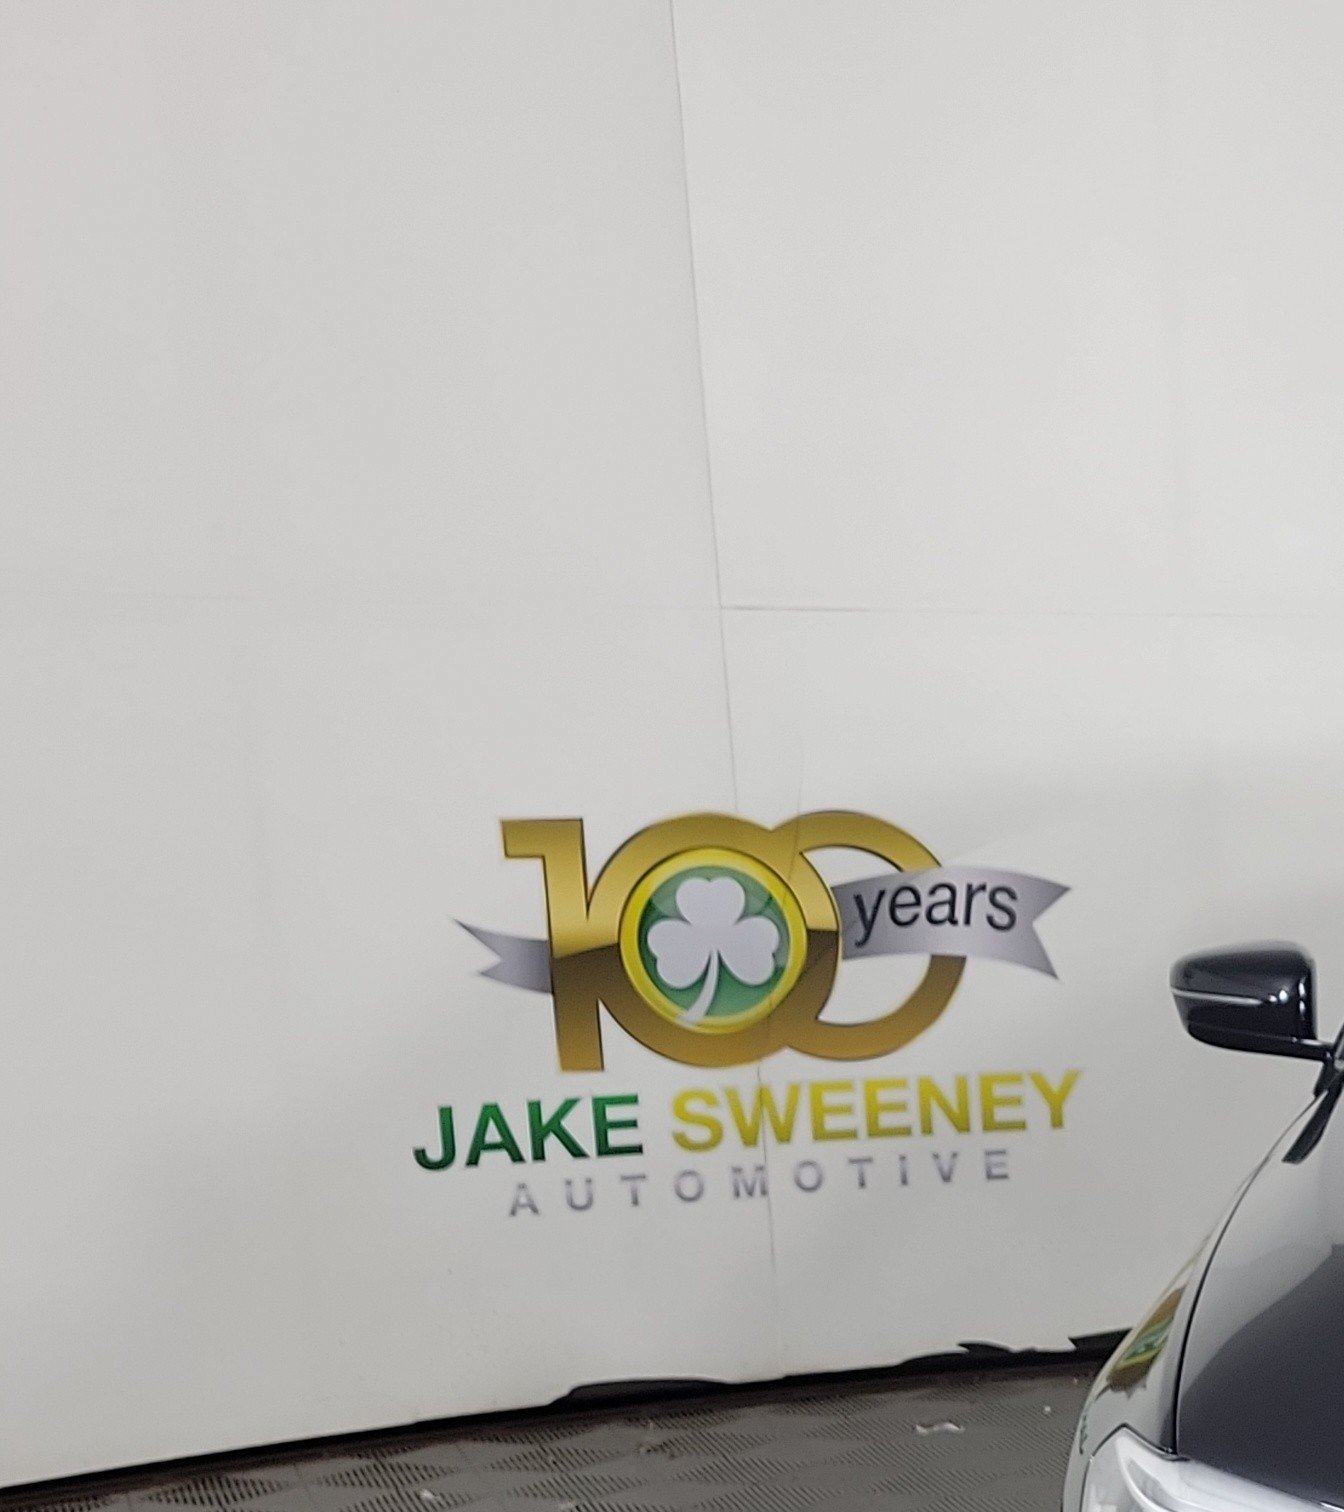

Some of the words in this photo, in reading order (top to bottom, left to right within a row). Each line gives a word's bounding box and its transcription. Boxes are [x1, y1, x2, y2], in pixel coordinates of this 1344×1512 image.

[499, 810, 967, 1073] 100
[853, 881, 1020, 948] years
[412, 1094, 645, 1172] JAKE
[670, 1070, 1083, 1154] SWEENEY
[508, 1149, 1010, 1219] AUTOMOTIVE
